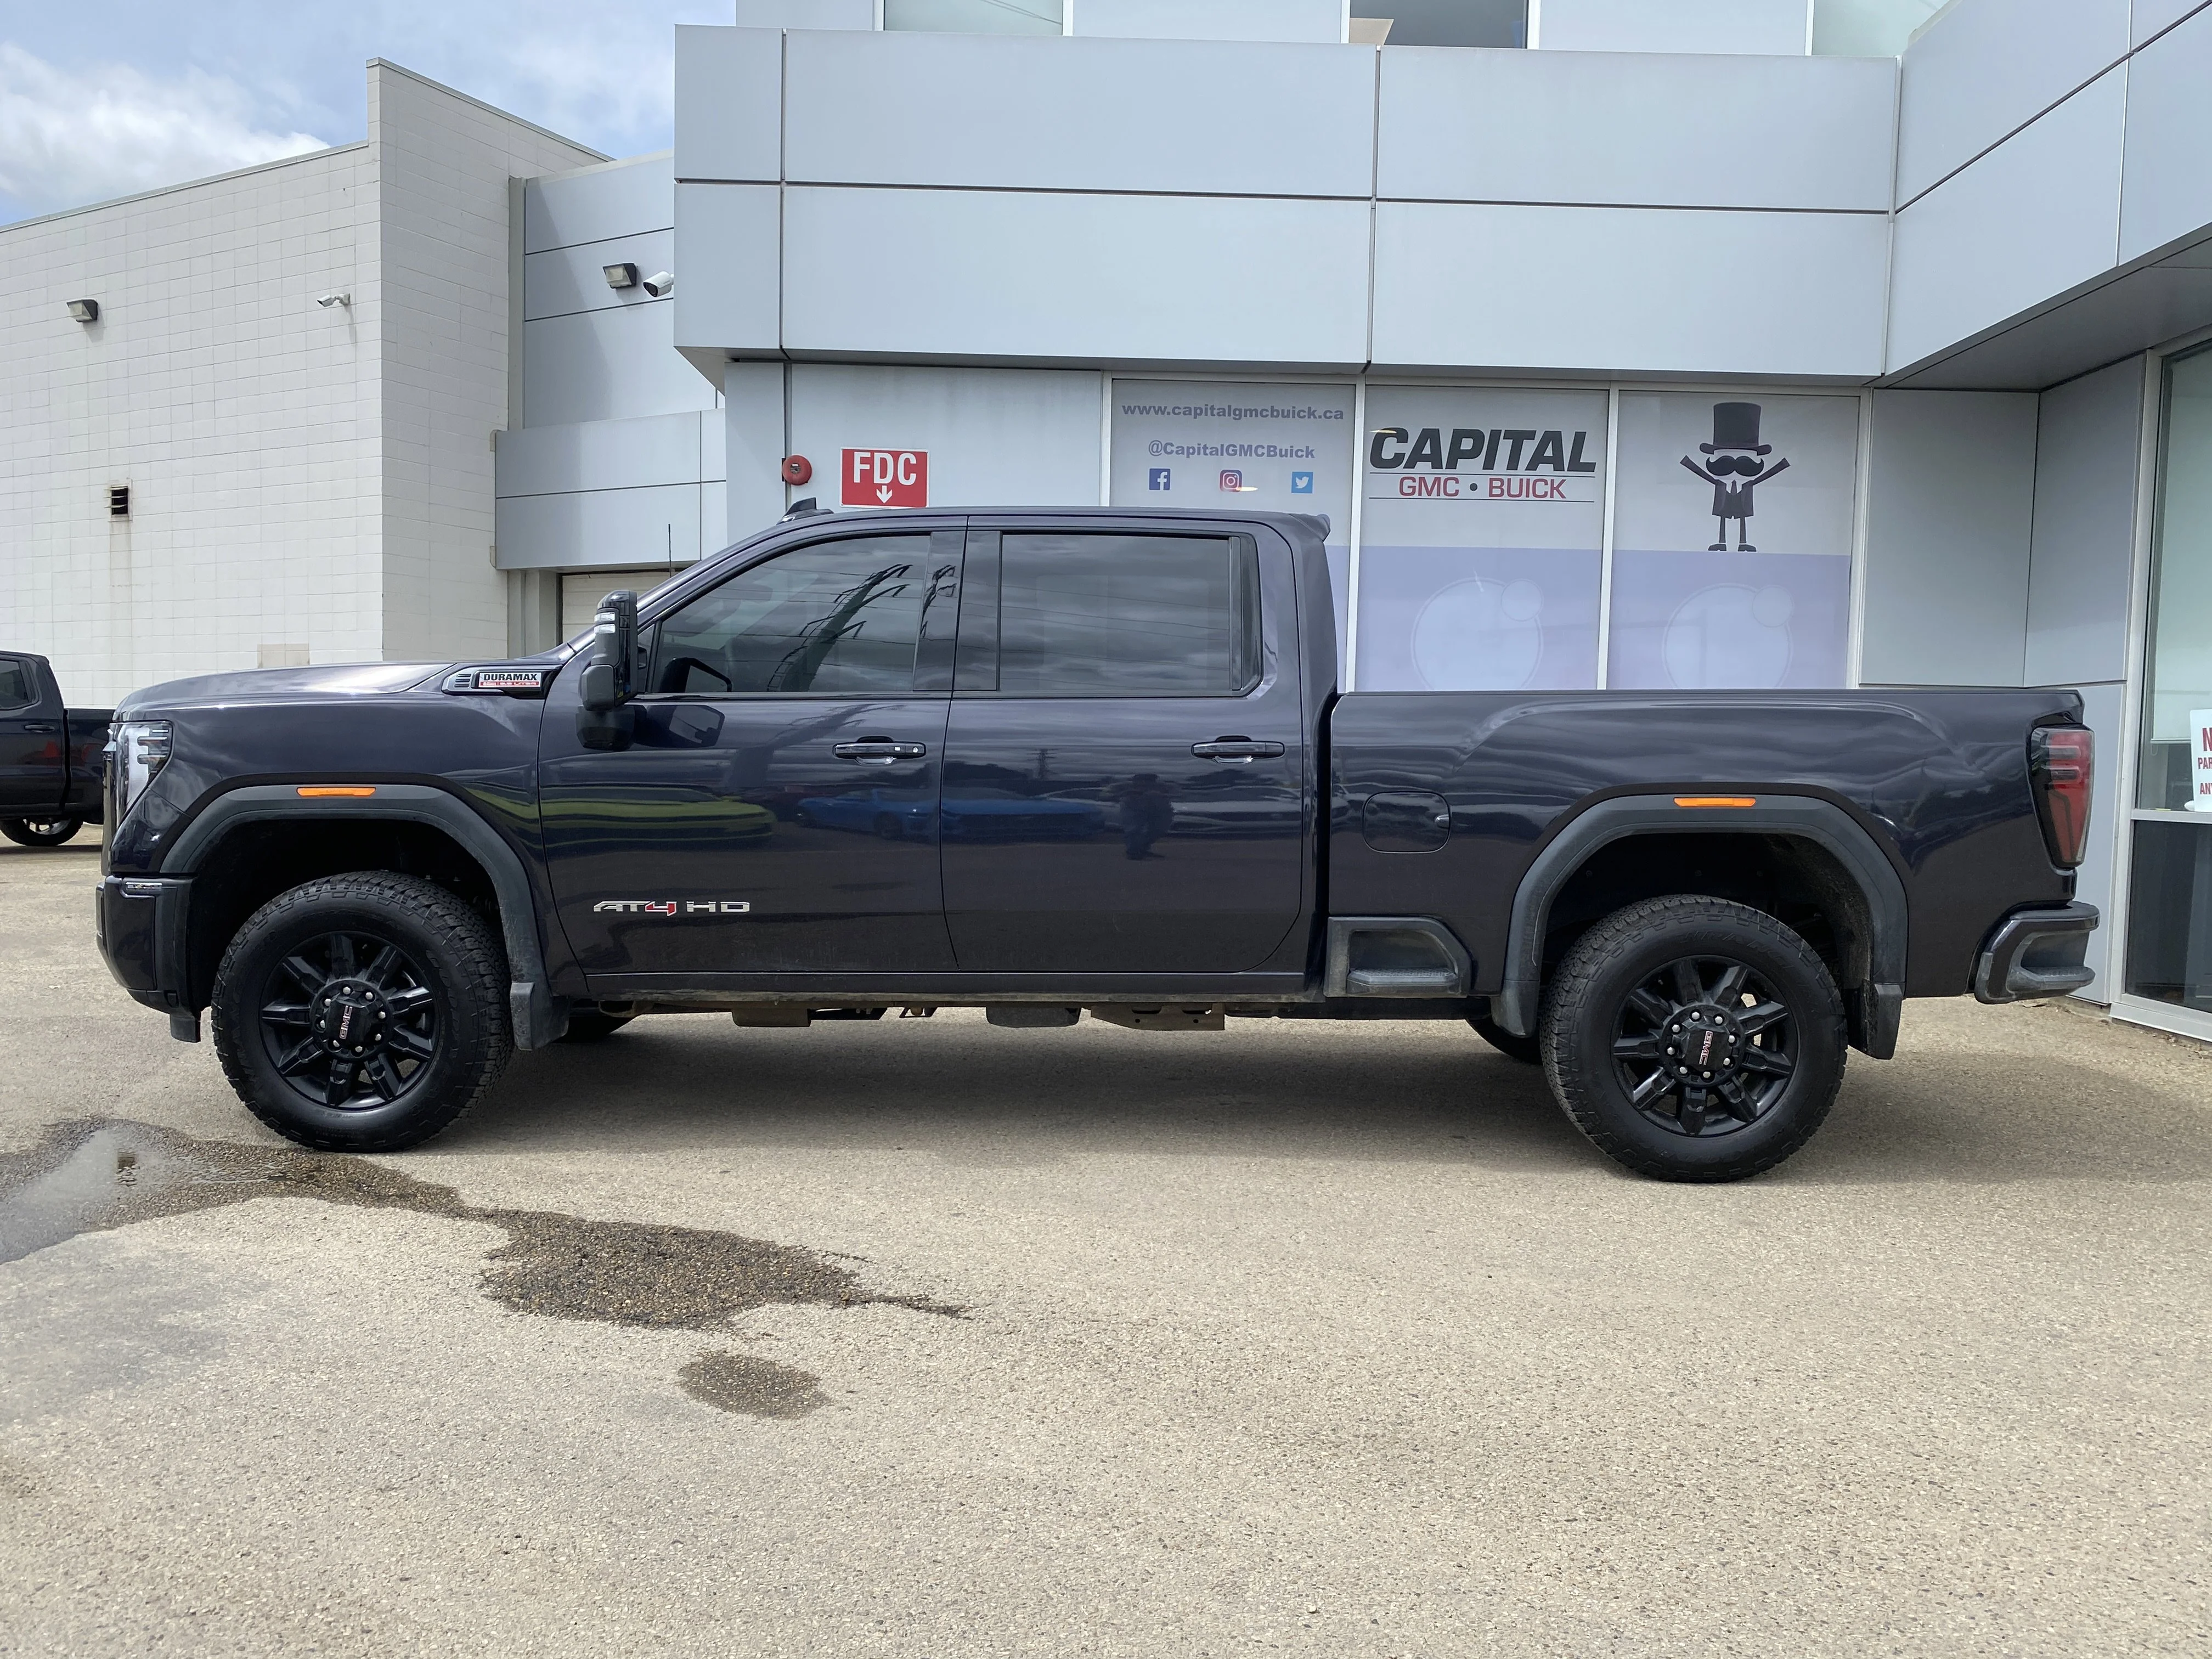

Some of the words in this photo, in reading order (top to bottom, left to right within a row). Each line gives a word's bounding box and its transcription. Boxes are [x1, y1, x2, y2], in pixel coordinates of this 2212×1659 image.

[1121, 404, 1344, 421] www.capitalgmcbuick.ca
[1148, 439, 1316, 459] @CapitalGMCBuick
[1369, 427, 1596, 473] CAPITAL
[853, 452, 917, 486] FDC
[1398, 476, 1460, 498] GMC
[1488, 477, 1567, 500] BUICK
[2199, 782, 2212, 795] AN
[593, 901, 677, 916] AT4
[686, 901, 750, 912] HD
[339, 1005, 353, 1040] GMC
[1699, 1030, 1713, 1065] GMC
